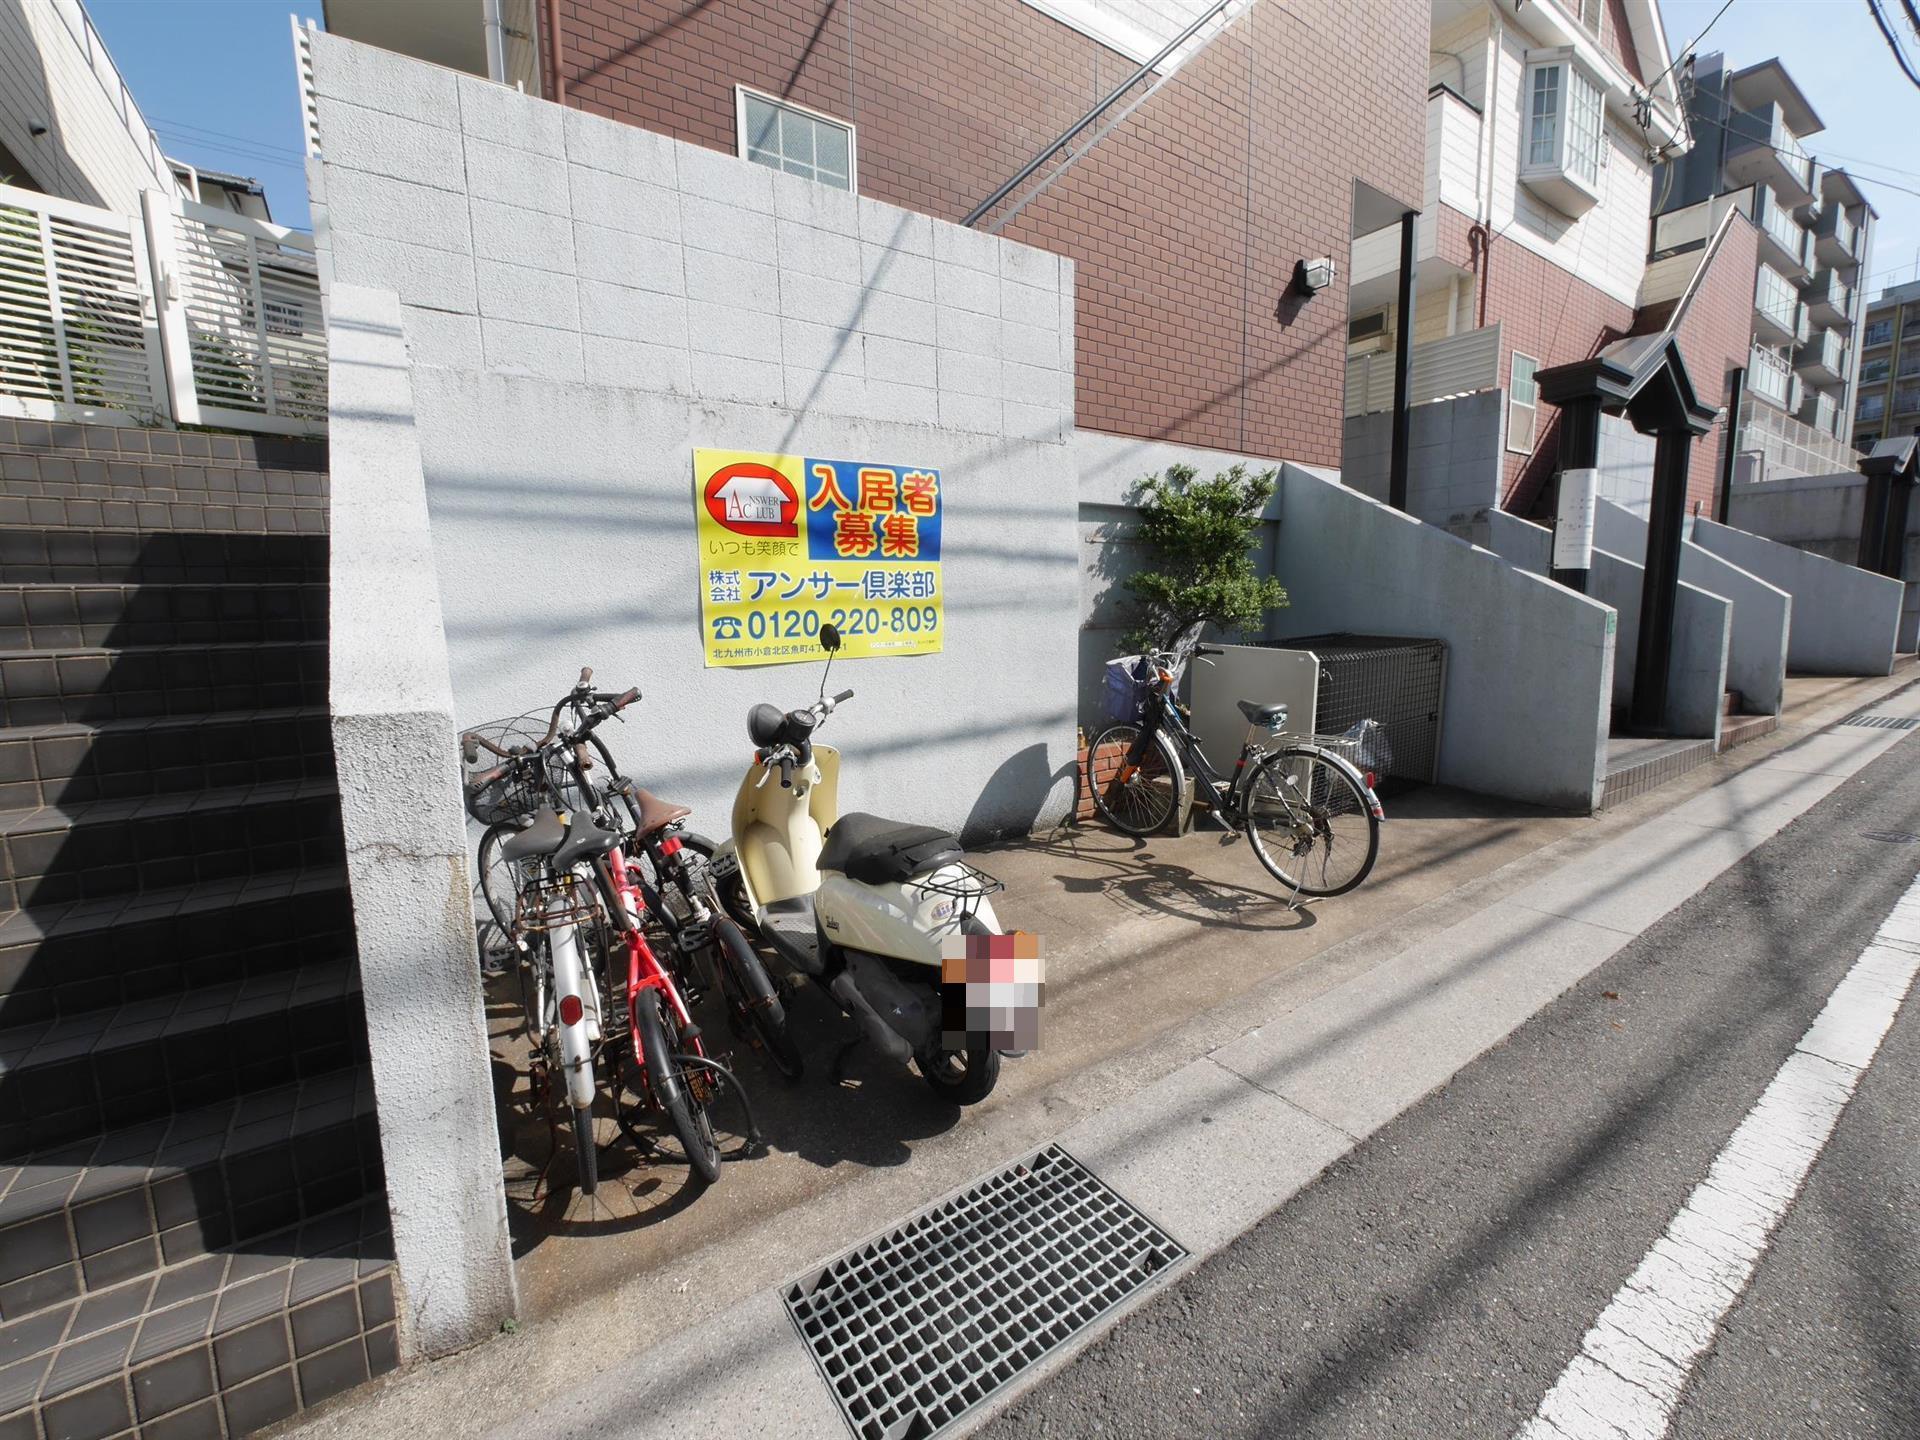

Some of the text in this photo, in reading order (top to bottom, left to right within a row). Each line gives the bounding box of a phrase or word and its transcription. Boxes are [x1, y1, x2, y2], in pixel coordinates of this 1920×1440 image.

[809, 466, 937, 515] 入居者
[709, 540, 799, 556] いつも笑顔で
[835, 513, 917, 556] 募集
[709, 570, 740, 585] 株式
[748, 570, 936, 600] アンサー倶楽部
[710, 587, 741, 602] 会社
[748, 606, 937, 639] 0120220-809
